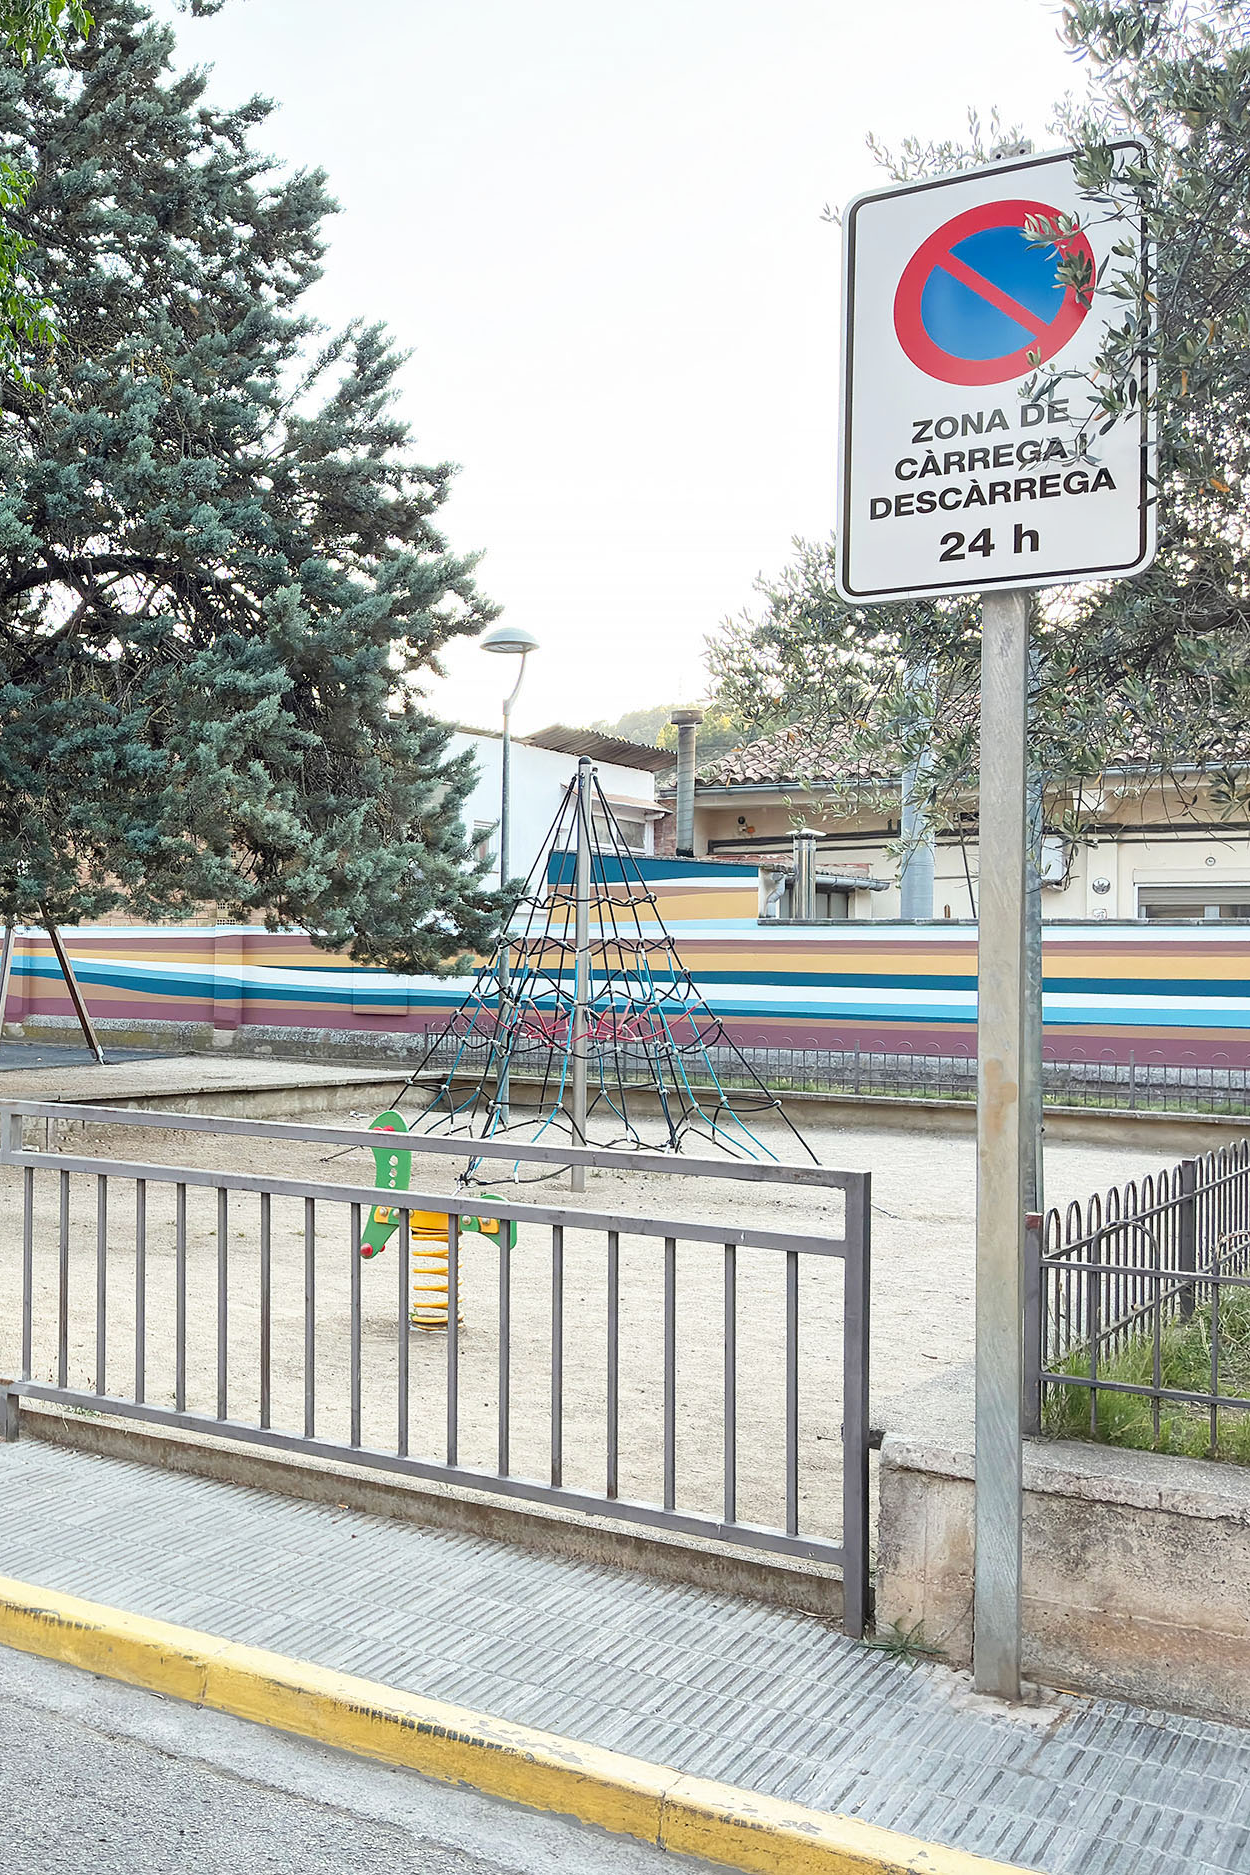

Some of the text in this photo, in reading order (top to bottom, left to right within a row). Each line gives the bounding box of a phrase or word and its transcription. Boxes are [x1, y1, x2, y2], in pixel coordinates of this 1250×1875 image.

[911, 398, 1070, 444] ZONA DE
[894, 436, 1069, 482] CÀRREGA
[869, 467, 1117, 520] DESCÀRREGA
[939, 523, 1040, 562] 24 h
